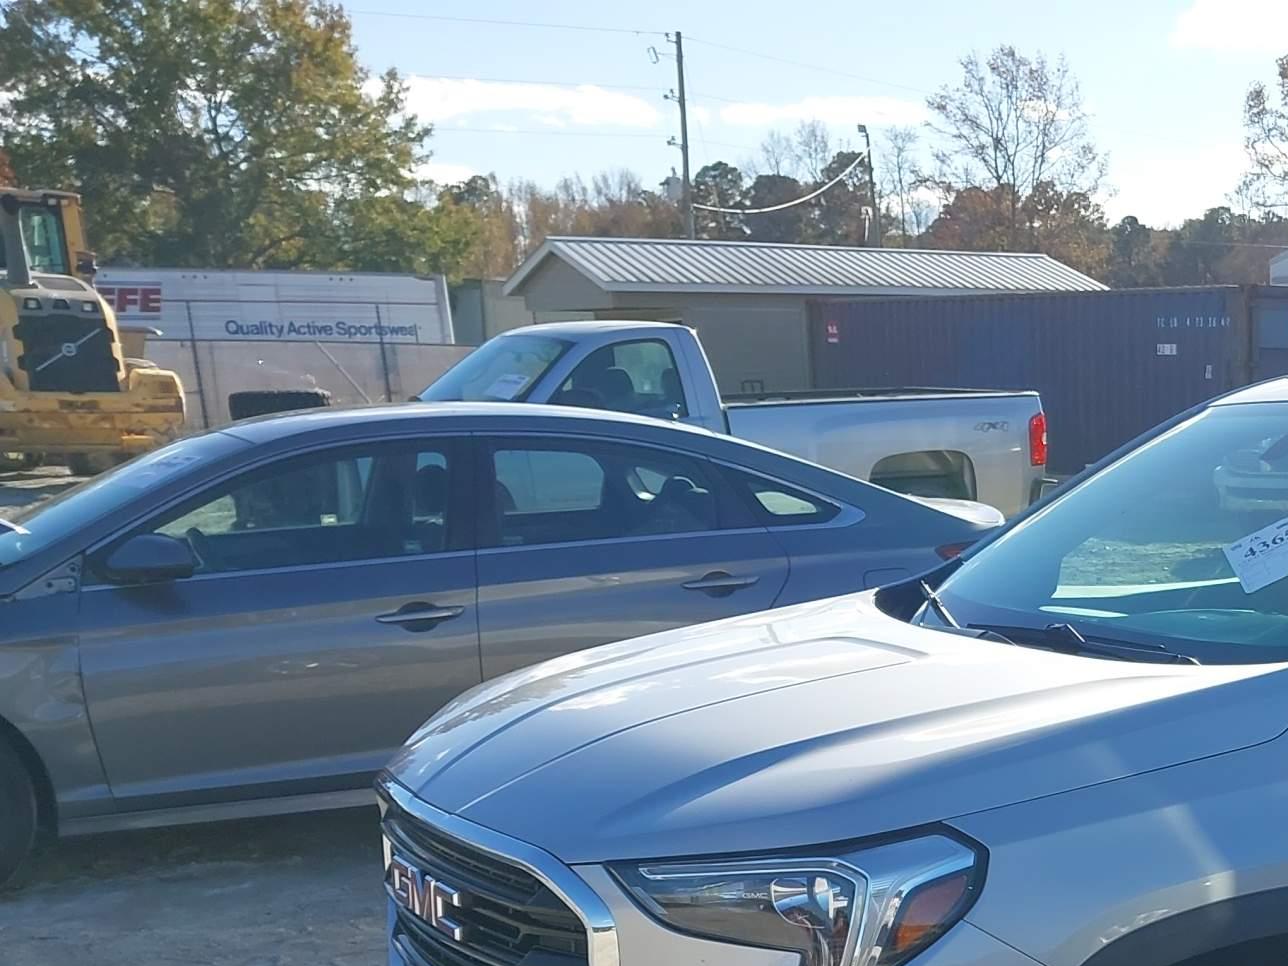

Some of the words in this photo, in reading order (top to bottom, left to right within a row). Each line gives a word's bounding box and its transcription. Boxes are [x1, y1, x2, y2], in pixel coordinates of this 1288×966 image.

[225, 320, 284, 338] Quality
[287, 321, 333, 336] Active
[391, 854, 462, 941] GMC
